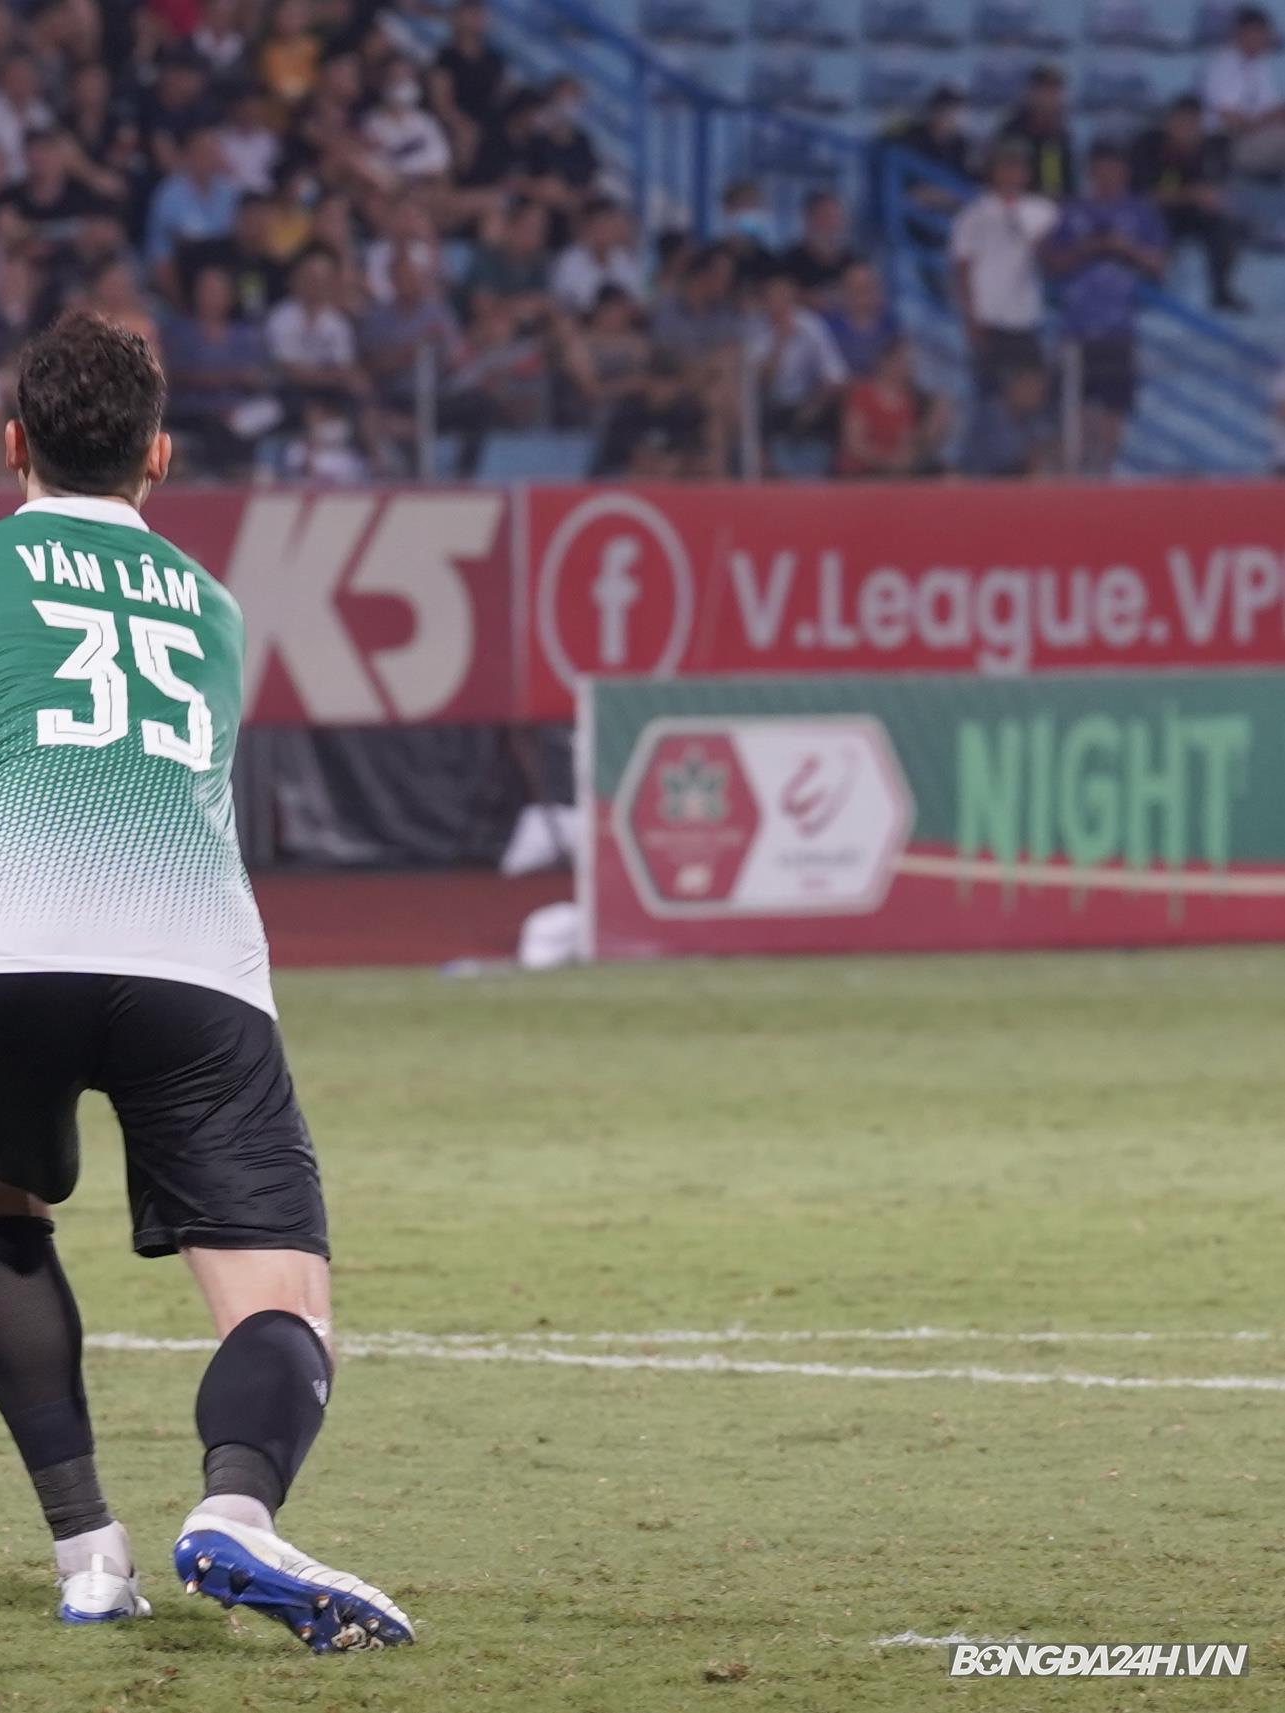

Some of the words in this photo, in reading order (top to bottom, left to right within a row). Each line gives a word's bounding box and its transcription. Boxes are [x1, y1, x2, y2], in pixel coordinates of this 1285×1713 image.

[16, 539, 105, 593] VĂN
[114, 553, 201, 616] LÂM
[224, 492, 502, 720] K5
[729, 546, 1285, 675] V.League.VP
[32, 600, 213, 772] 35
[957, 700, 1250, 925] NIGHT
